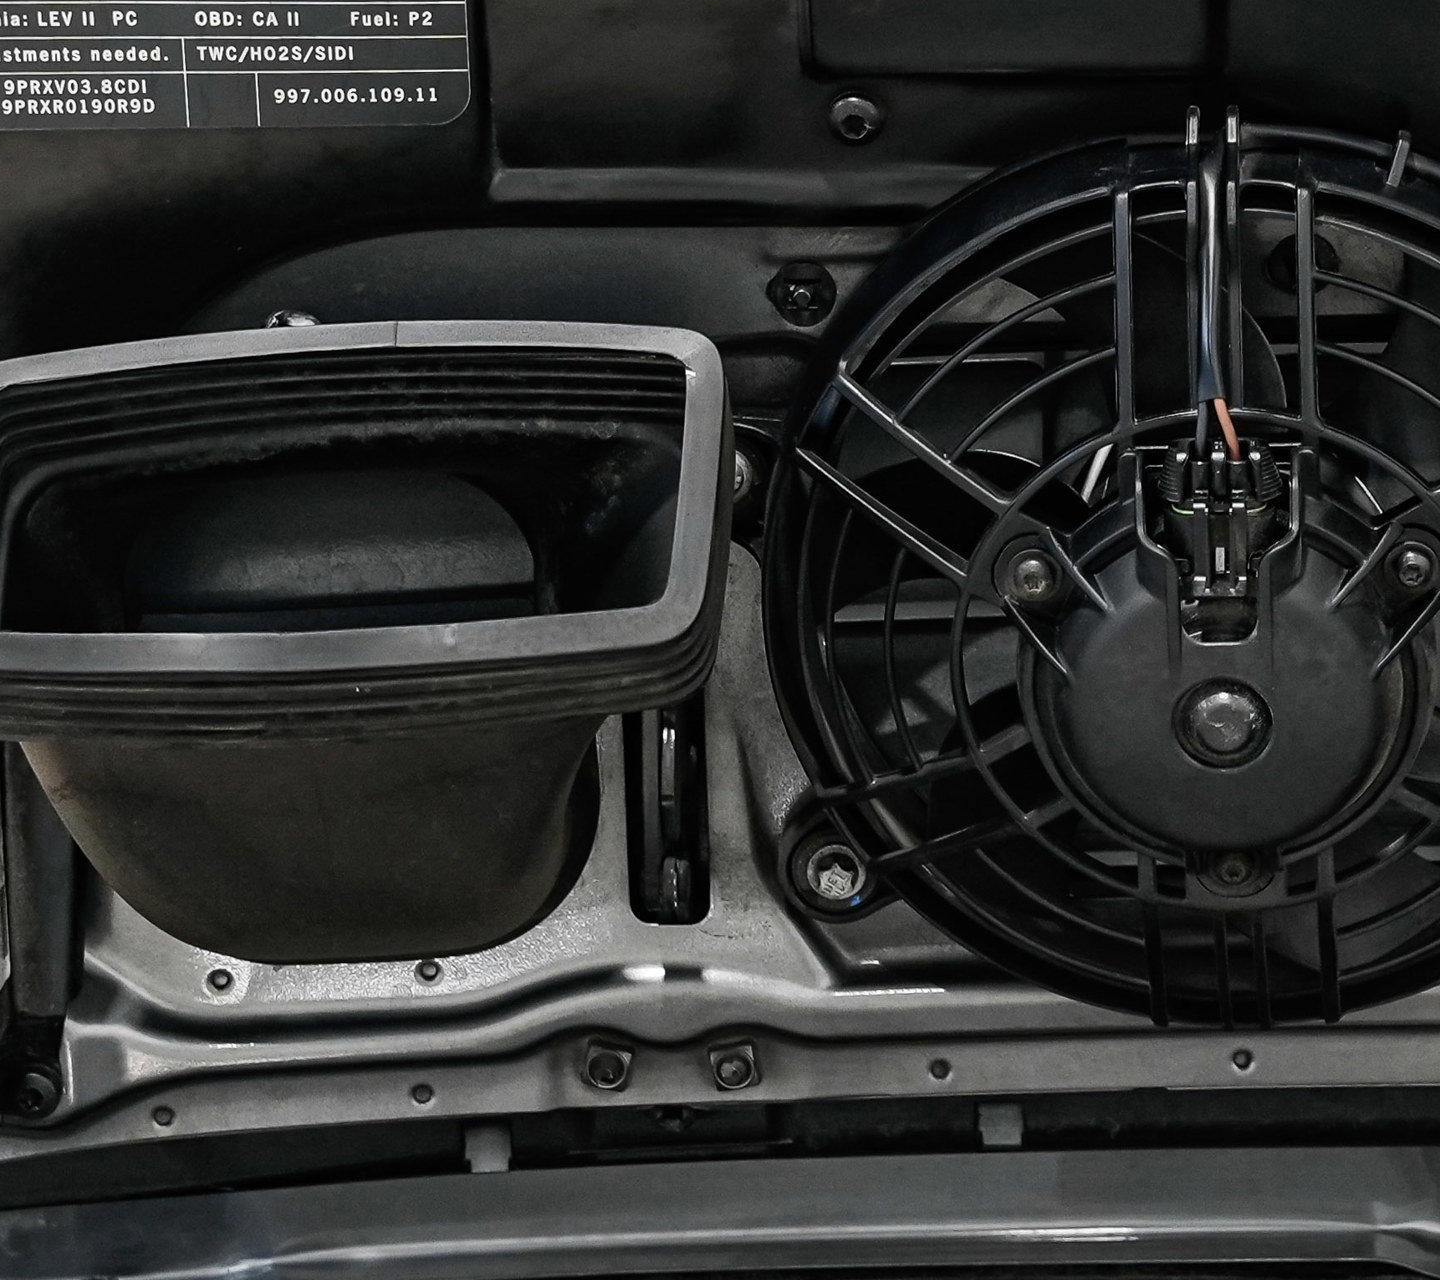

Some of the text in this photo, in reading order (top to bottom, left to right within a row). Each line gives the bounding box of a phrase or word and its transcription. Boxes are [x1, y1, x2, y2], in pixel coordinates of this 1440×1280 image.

[37, 10, 73, 27] LEV
[81, 10, 95, 27] II
[112, 10, 138, 27] PC
[194, 10, 242, 27] OBD:
[252, 10, 279, 27] CA
[287, 11, 299, 27] II
[350, 11, 399, 27] Fuel:
[408, 10, 433, 27] P2
[90, 45, 169, 62] needed.
[196, 45, 354, 63] TWC/HO2S/SIDI
[273, 87, 438, 104] 997.006.109.11
